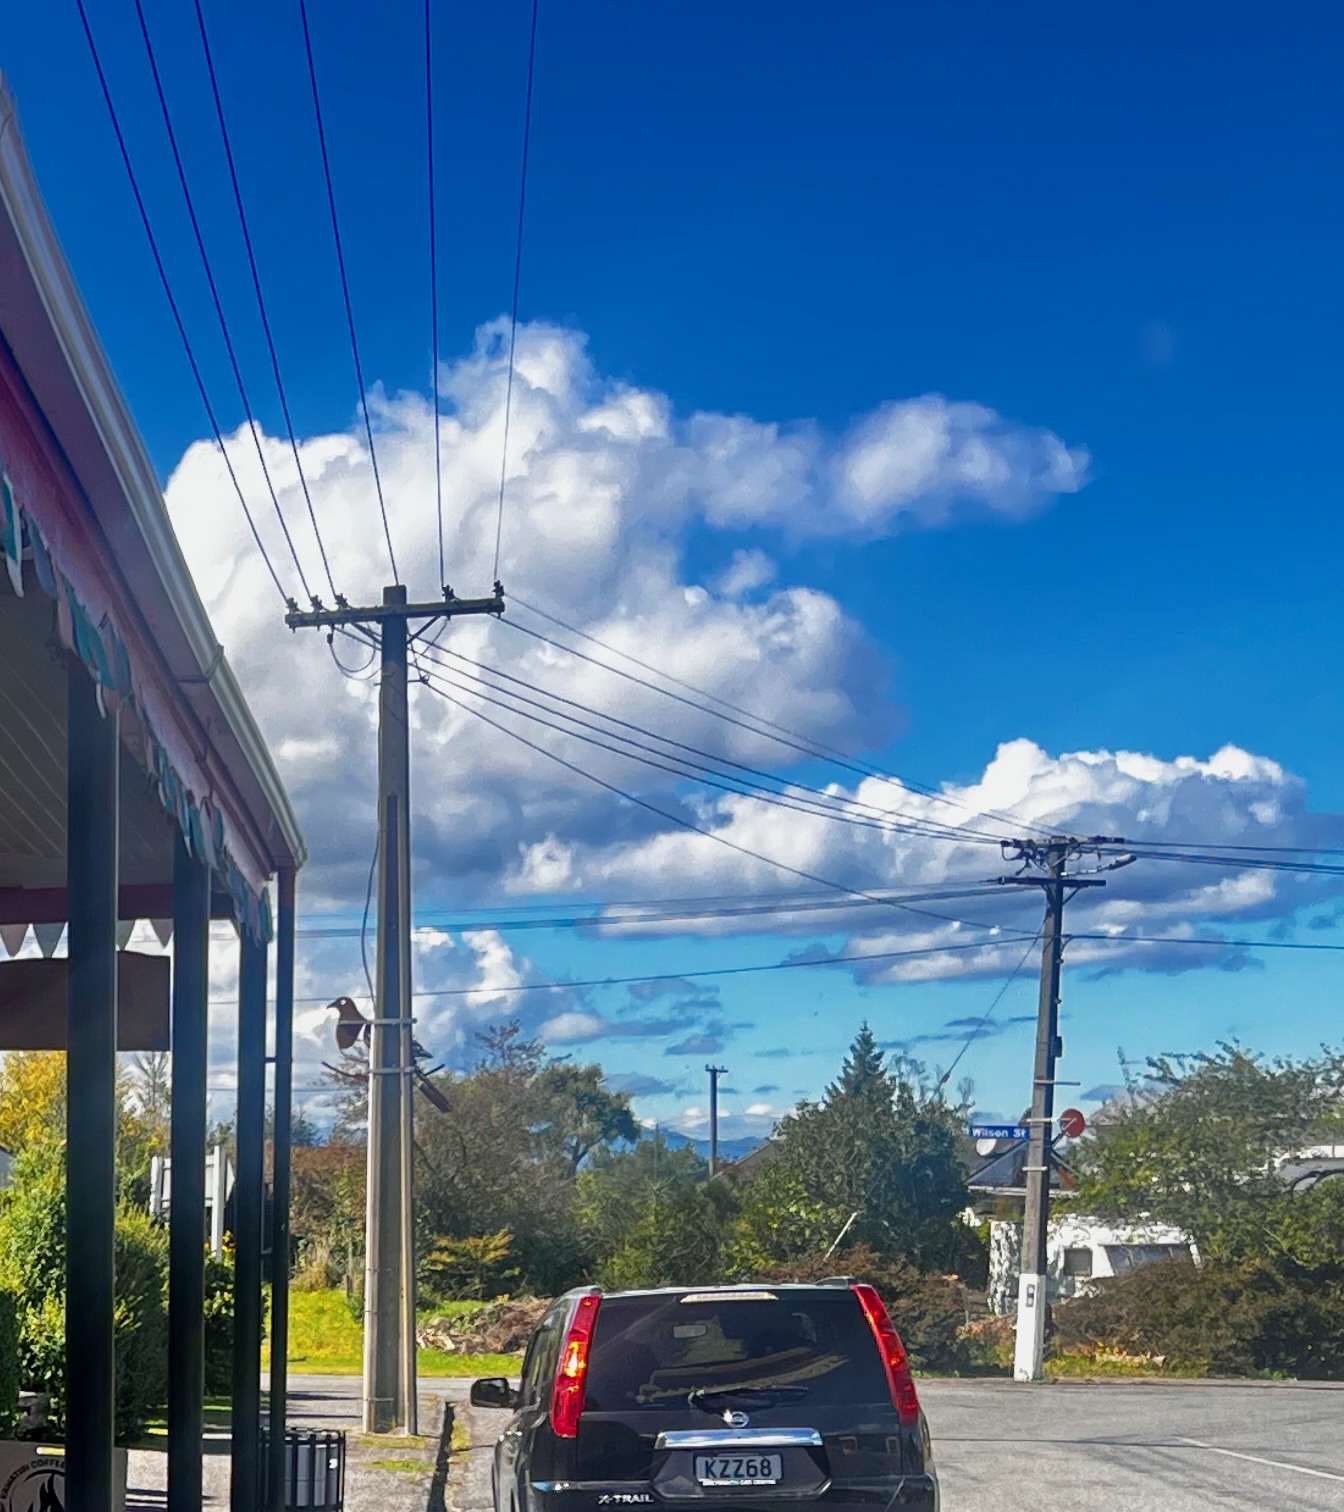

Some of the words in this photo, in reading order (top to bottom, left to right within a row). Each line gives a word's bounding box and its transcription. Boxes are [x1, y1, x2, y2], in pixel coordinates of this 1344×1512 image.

[972, 1128, 1009, 1137] Wilson
[1013, 1129, 1026, 1138] St
[704, 1458, 773, 1479] KZZ68
[597, 1494, 654, 1505] X-TRAIL
